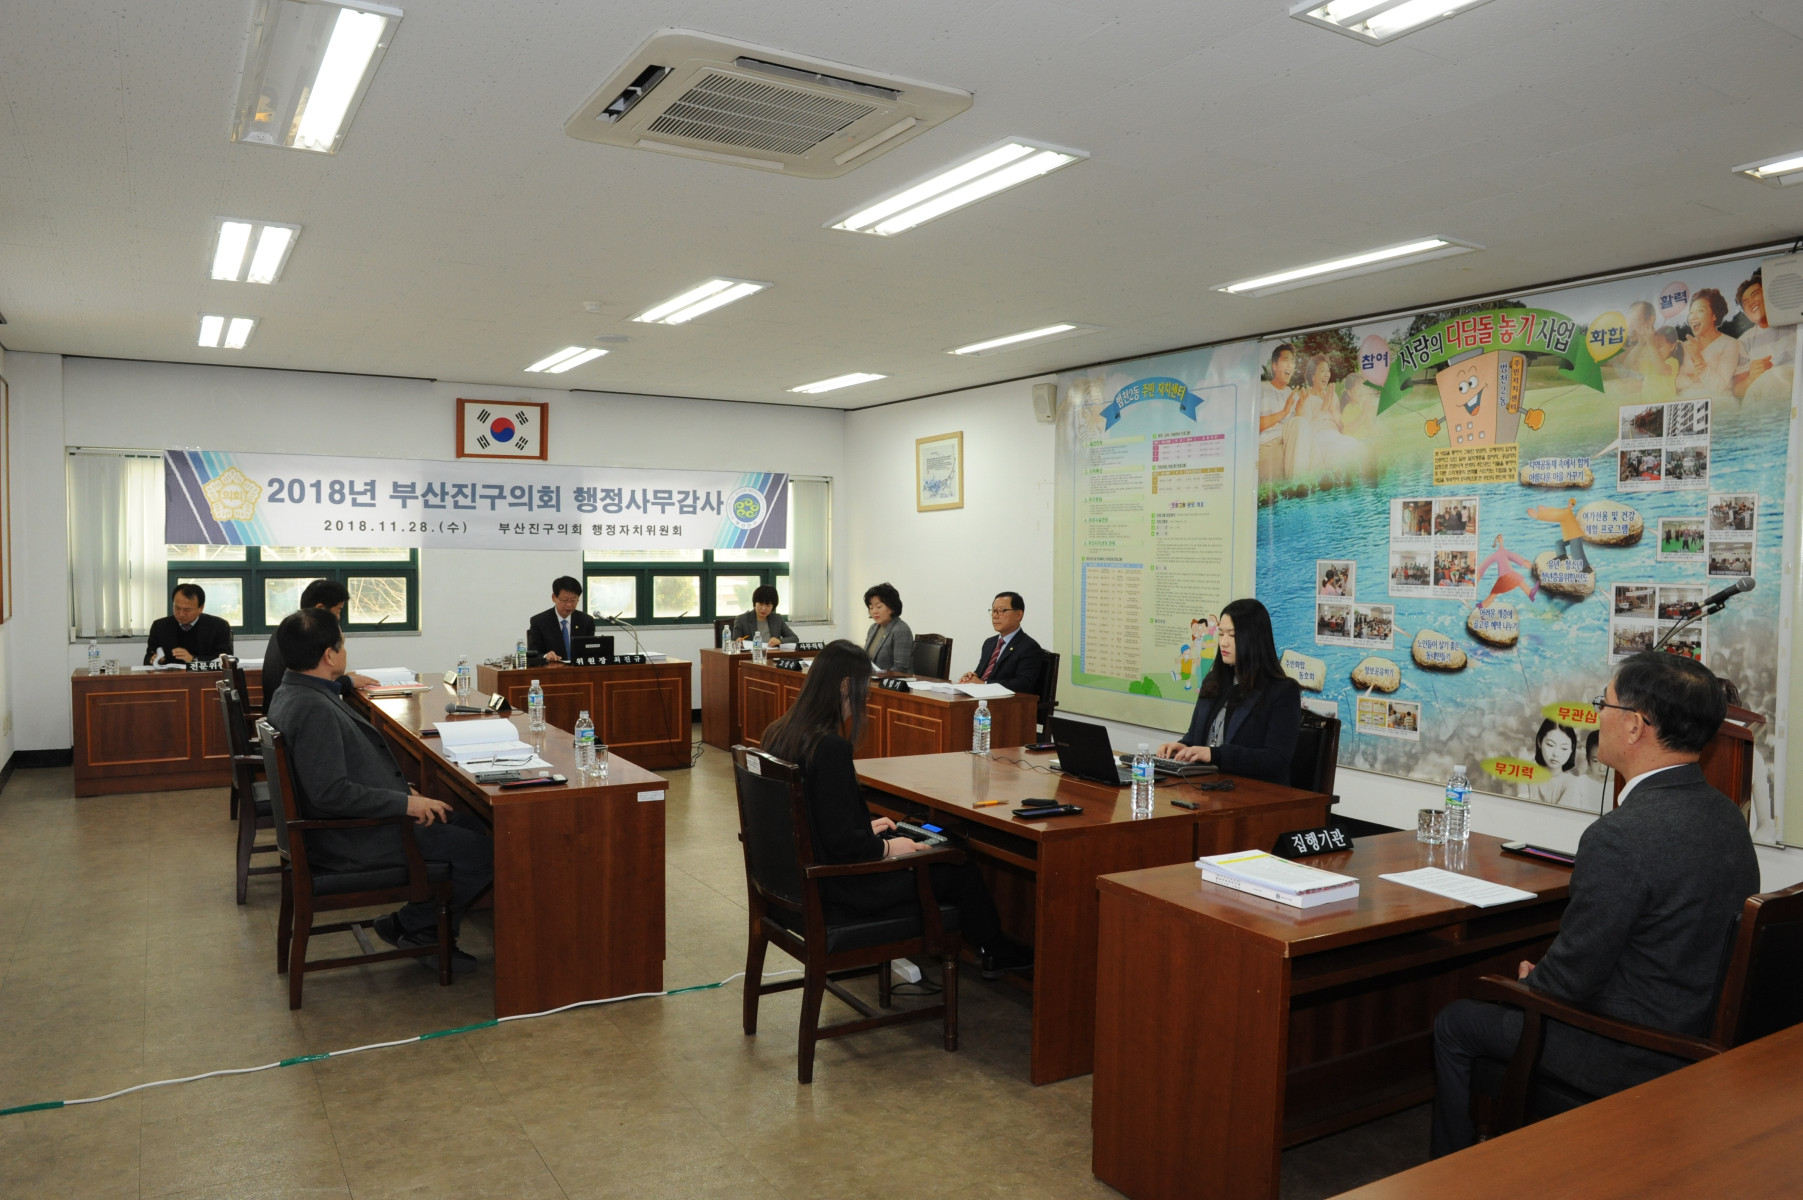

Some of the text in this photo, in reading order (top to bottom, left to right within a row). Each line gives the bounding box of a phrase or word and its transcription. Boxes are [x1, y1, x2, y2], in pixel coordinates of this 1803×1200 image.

[1660, 290, 1688, 309] 활력
[1398, 332, 1444, 372] 사랑의
[1445, 314, 1495, 349] 디딤돌
[1589, 326, 1626, 347] 화합
[1361, 352, 1389, 371] 참여
[1142, 382, 1155, 398] 주민
[1158, 382, 1187, 402] 자치센터
[1529, 457, 1590, 470] 지역공동체 속에서 함께
[1528, 471, 1584, 482] 아름다운 마을 가꾸기
[267, 478, 724, 516] 2018년 부산진구의회 행정사무감사
[1582, 511, 1636, 521] 여가선용 및 건강
[323, 519, 683, 537] 2018.11.28.(수) 부산진구의회 행정자치위원회
[1585, 524, 1629, 535] 체험 프로그램
[1480, 608, 1513, 619] 어려운 계층에
[1417, 640, 1460, 651] 노인들이 살기 좋은
[576, 656, 607, 665] 위원장
[1298, 672, 1315, 681] 동호회
[1558, 706, 1598, 724] 무관심
[1495, 762, 1534, 780] 무기력
[1291, 828, 1347, 854] 집행기관
